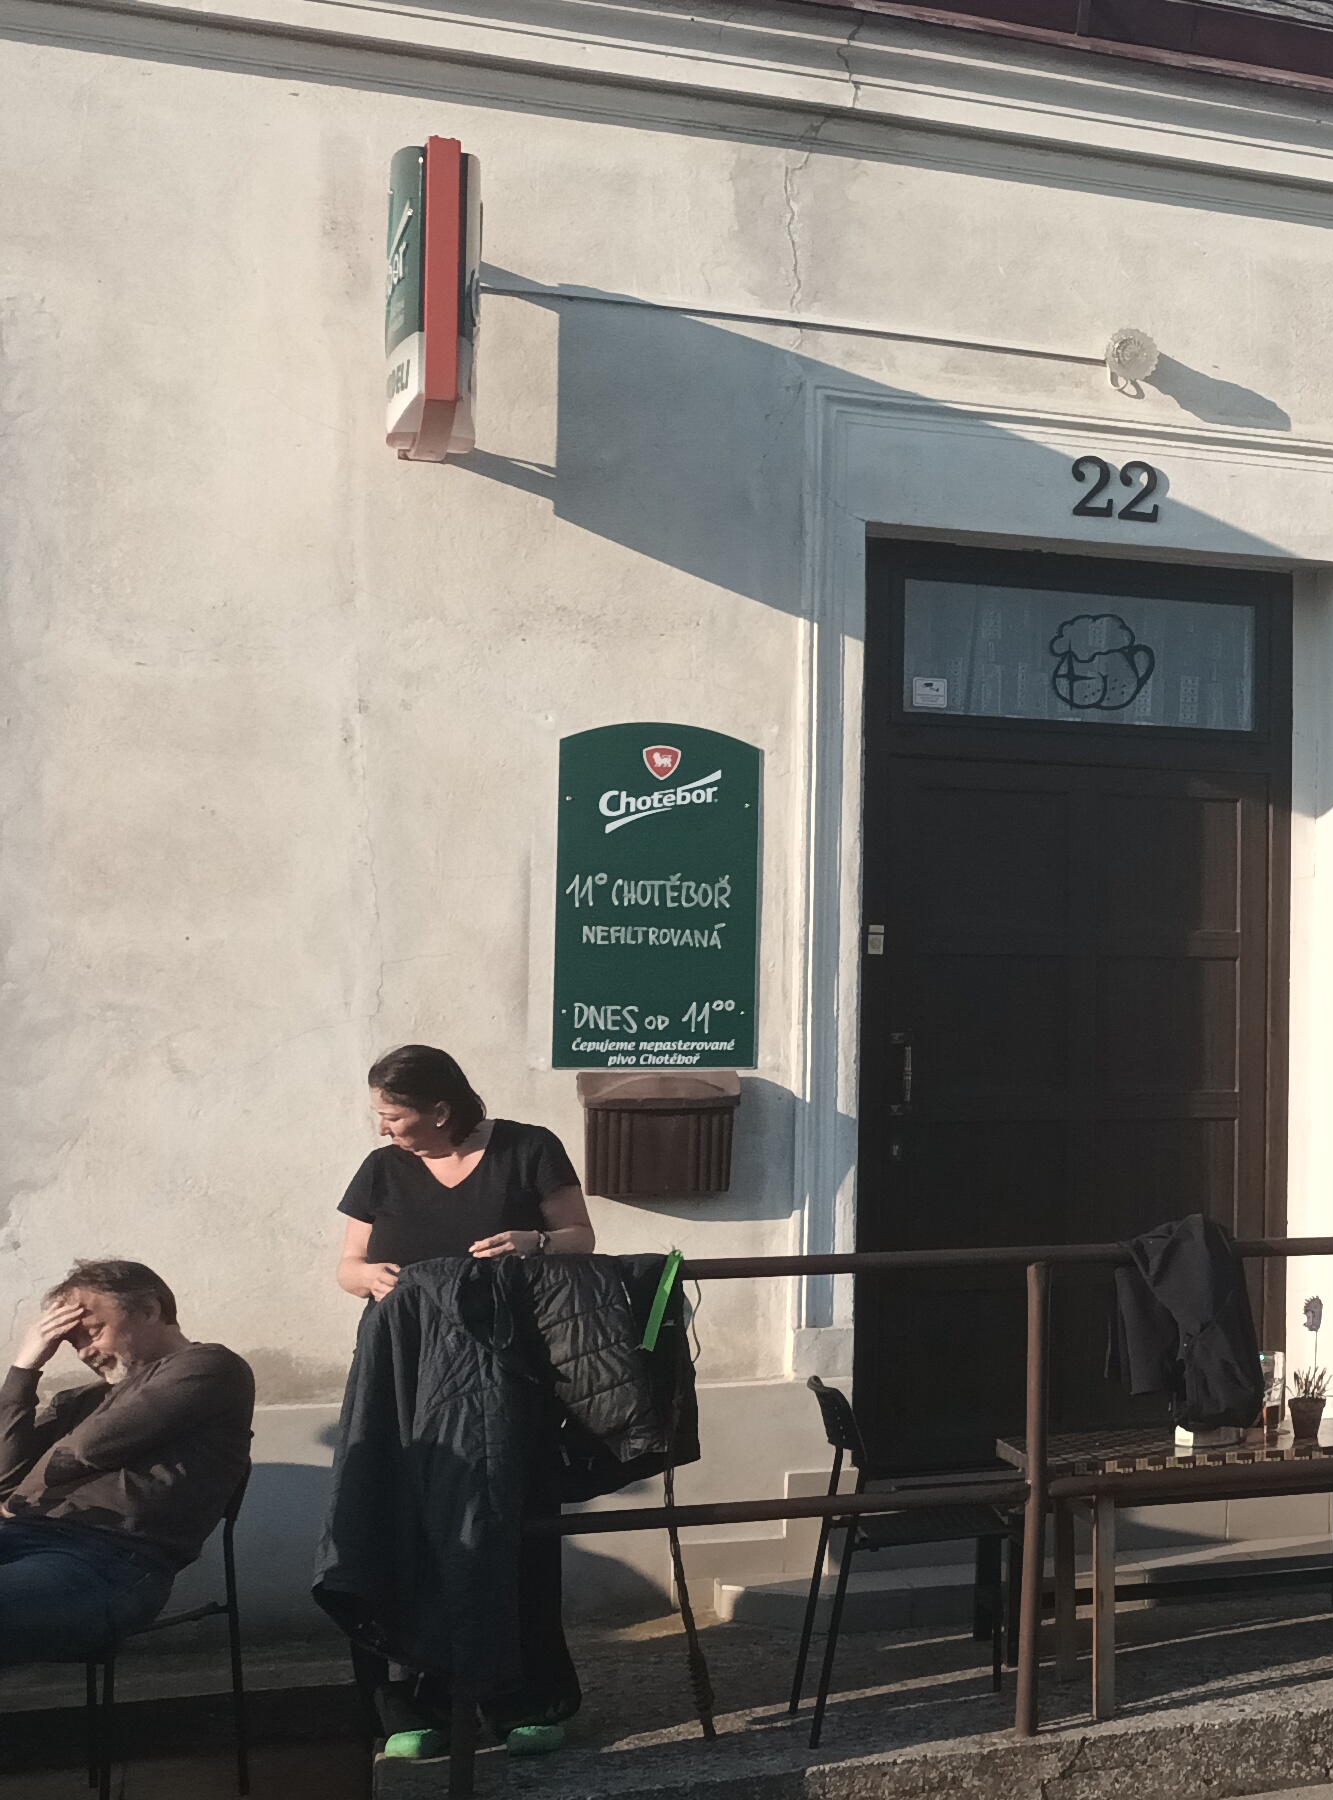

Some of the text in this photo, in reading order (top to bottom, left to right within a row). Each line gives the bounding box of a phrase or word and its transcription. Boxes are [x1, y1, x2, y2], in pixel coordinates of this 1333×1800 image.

[1071, 455, 1159, 522] 22
[611, 872, 732, 909] CHOTĚBOŘ
[582, 922, 727, 950] NEFILTROVANÁ
[573, 1002, 639, 1034] DNES
[571, 1036, 736, 1052] Čepujeme nepasterované
[607, 1052, 701, 1067] pivo Chotěboř
